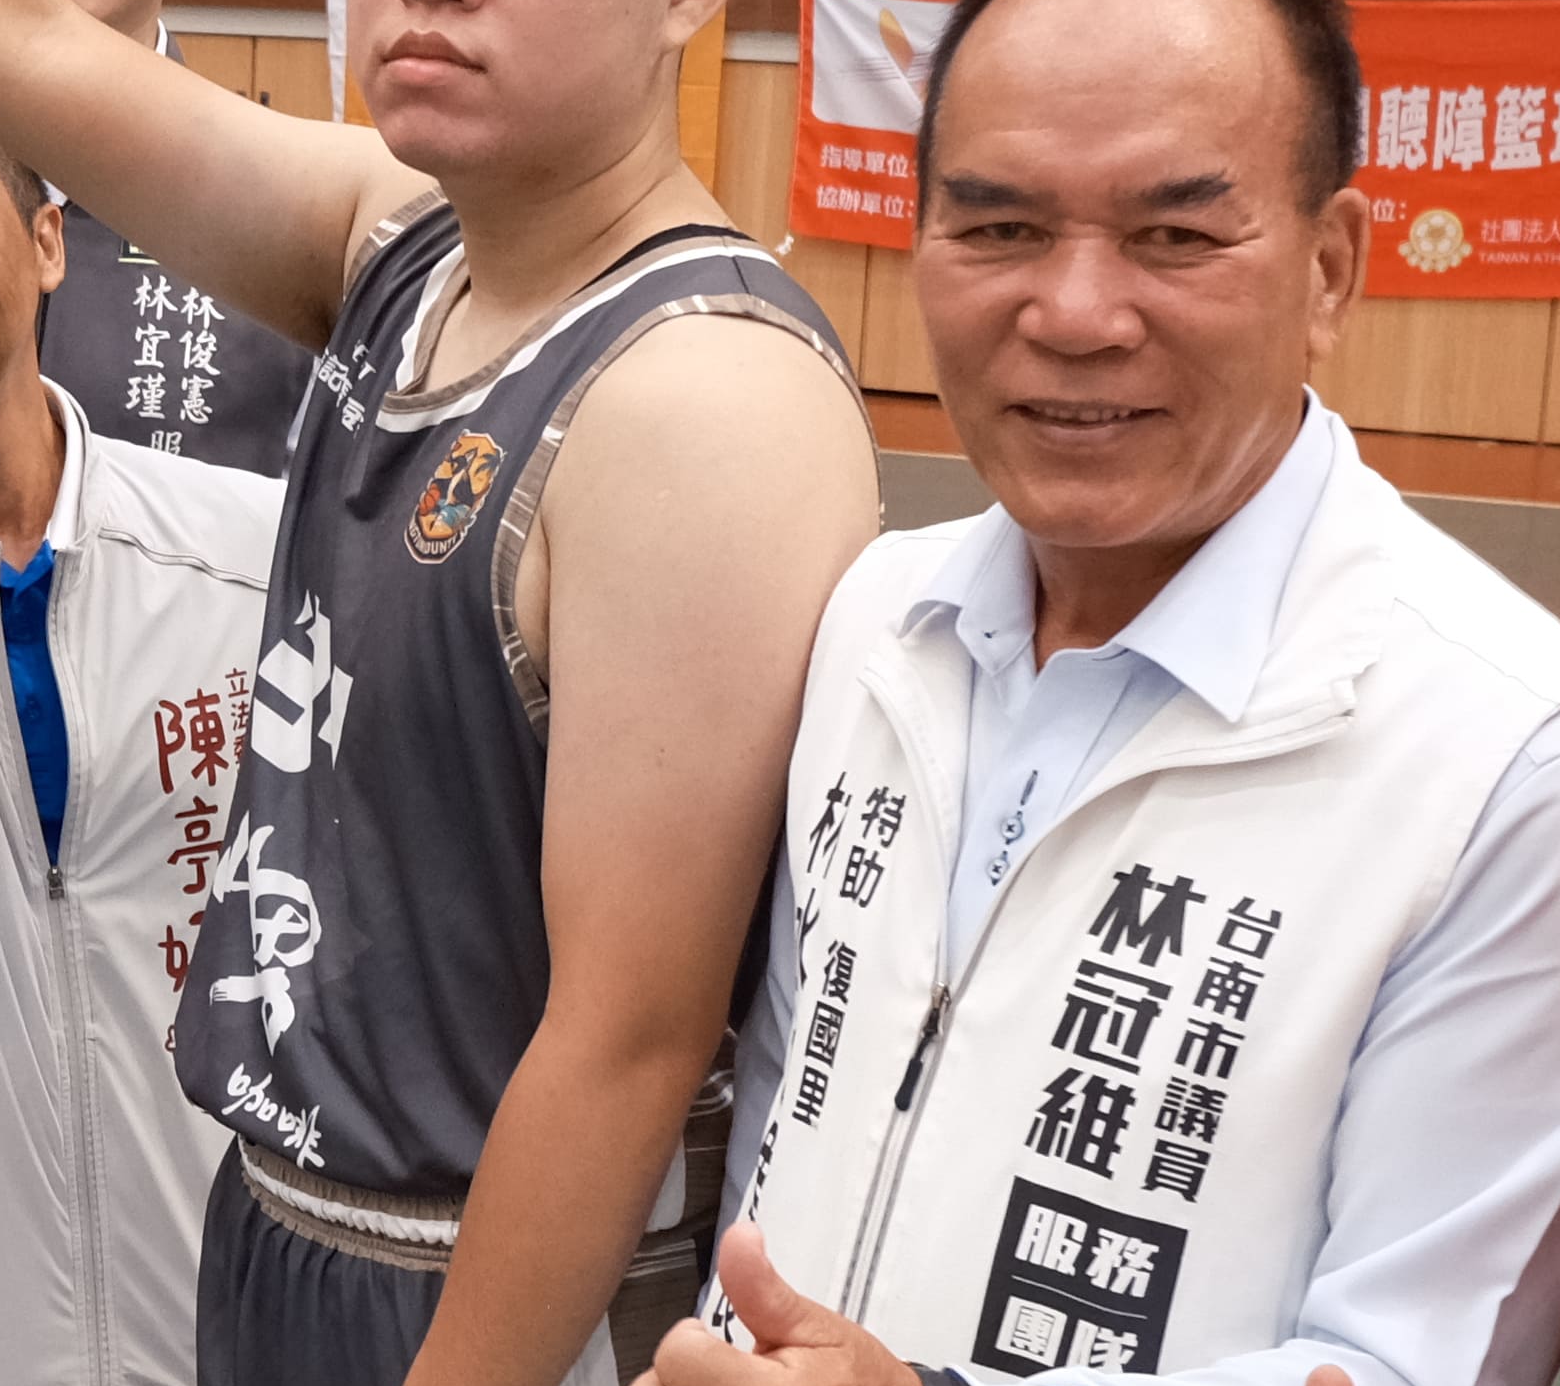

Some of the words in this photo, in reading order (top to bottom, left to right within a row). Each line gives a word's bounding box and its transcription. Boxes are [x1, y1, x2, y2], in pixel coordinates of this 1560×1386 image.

[1479, 250, 1529, 263] TAINAN
[125, 274, 178, 419] 林宜瑾
[179, 286, 225, 424] 林俊憲
[839, 785, 906, 909] 特助
[1024, 863, 1207, 1181] 林冠維
[1141, 896, 1283, 1204] 台南市議員
[1014, 1203, 1160, 1299] 服務
[994, 1294, 1139, 1373] 團隊
